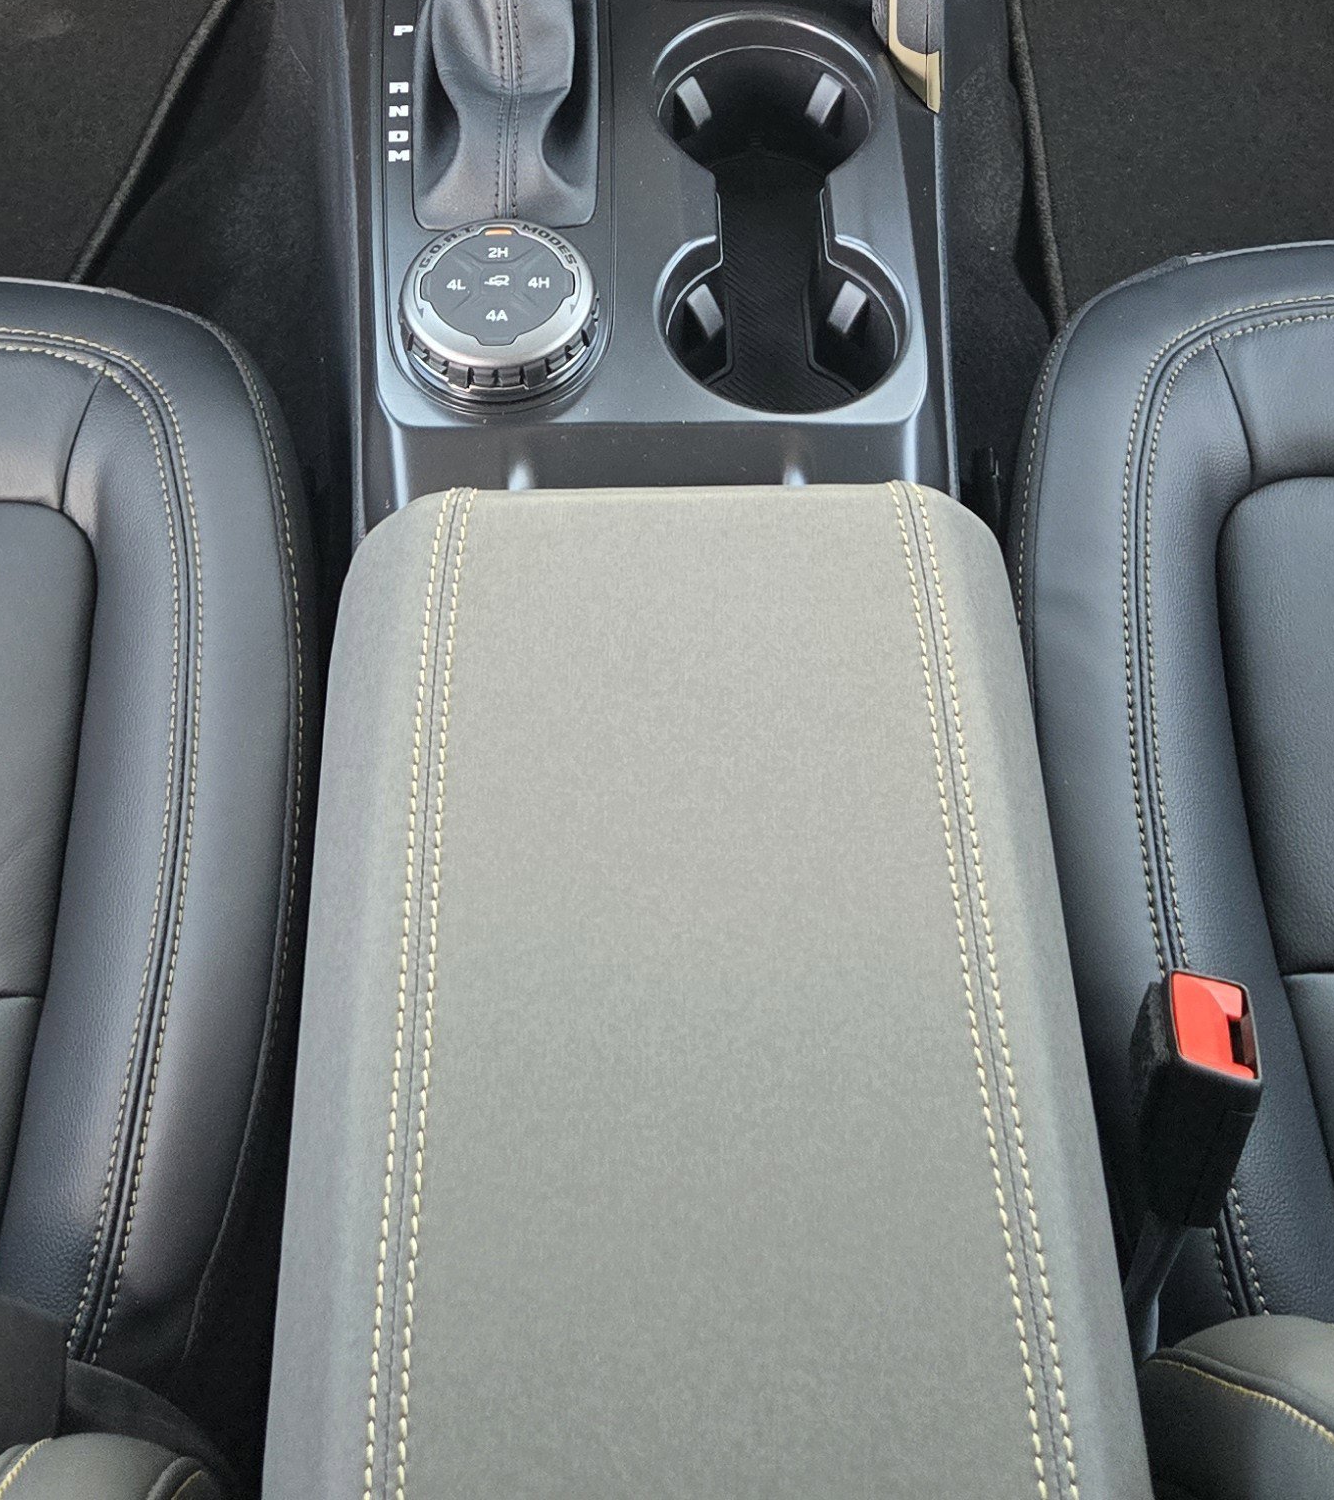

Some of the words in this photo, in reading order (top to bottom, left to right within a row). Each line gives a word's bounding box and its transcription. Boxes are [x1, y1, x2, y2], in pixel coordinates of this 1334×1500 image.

[393, 24, 414, 37] P
[389, 82, 410, 94] R
[389, 105, 409, 118] N
[389, 130, 409, 142] D
[389, 150, 410, 162] M
[522, 224, 577, 265] MODES
[488, 247, 508, 259] 2H
[447, 279, 466, 291] 4L
[528, 277, 550, 289] 4H
[485, 310, 508, 322] 4A
